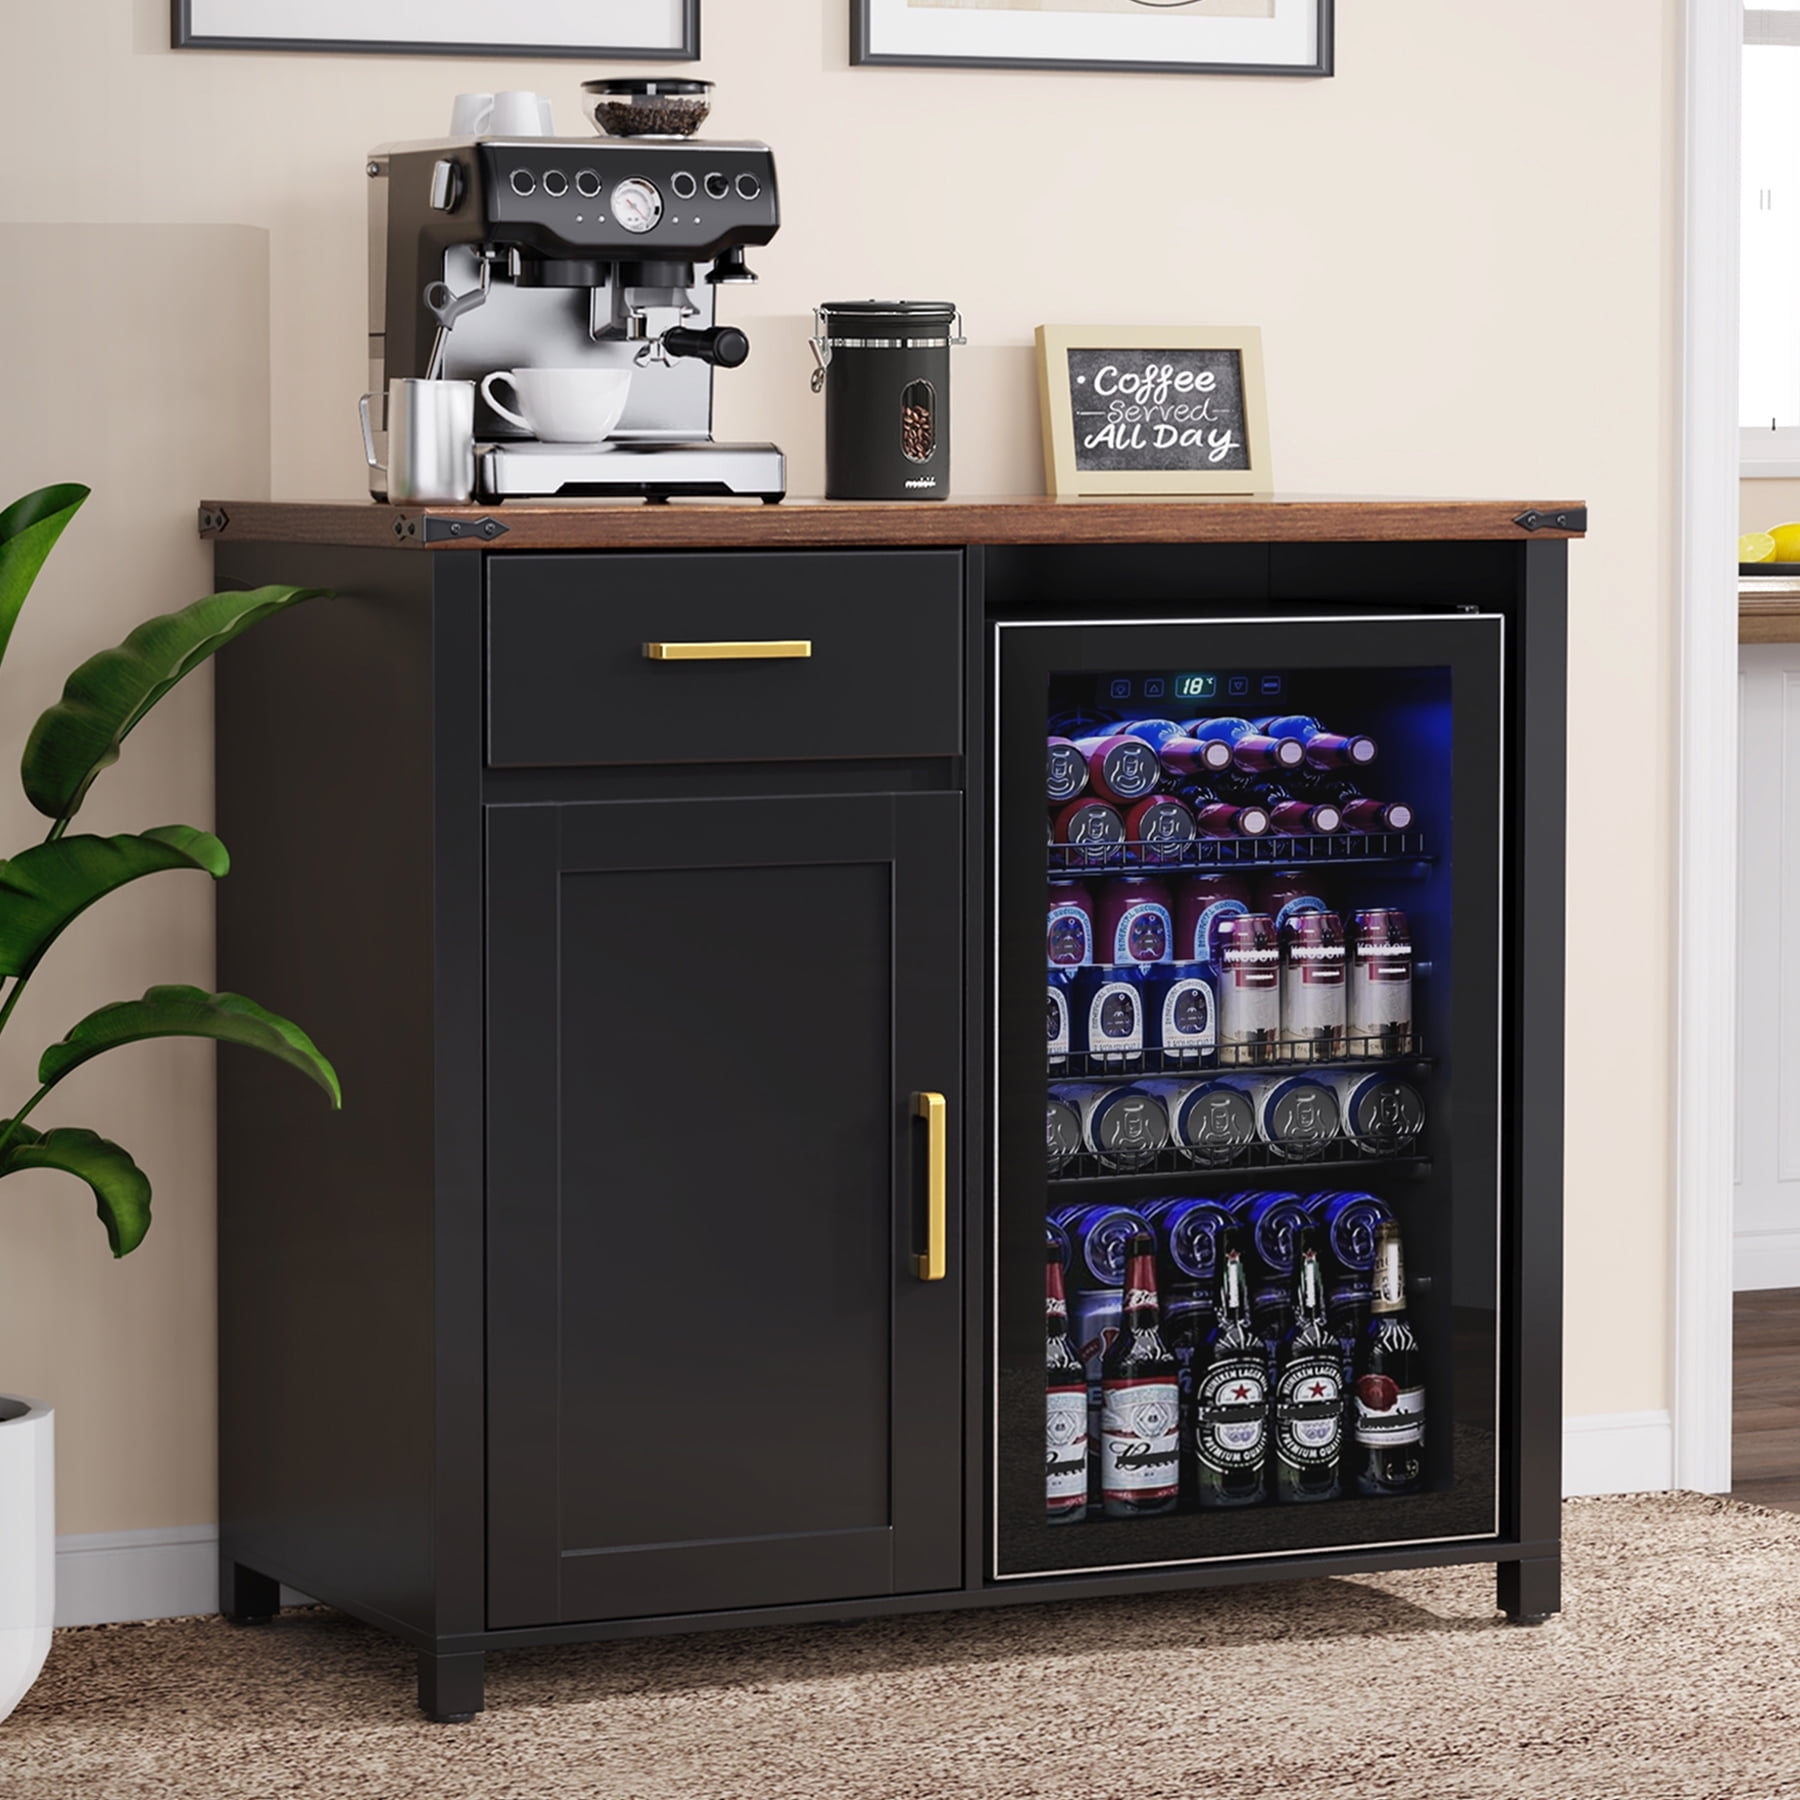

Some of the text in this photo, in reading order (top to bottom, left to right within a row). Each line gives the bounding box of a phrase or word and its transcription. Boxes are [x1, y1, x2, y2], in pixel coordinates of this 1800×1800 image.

[1094, 364, 1216, 405] Coffee
[1107, 398, 1218, 424] Served
[1084, 424, 1240, 462] All Day
[1183, 677, 1204, 695] 18
